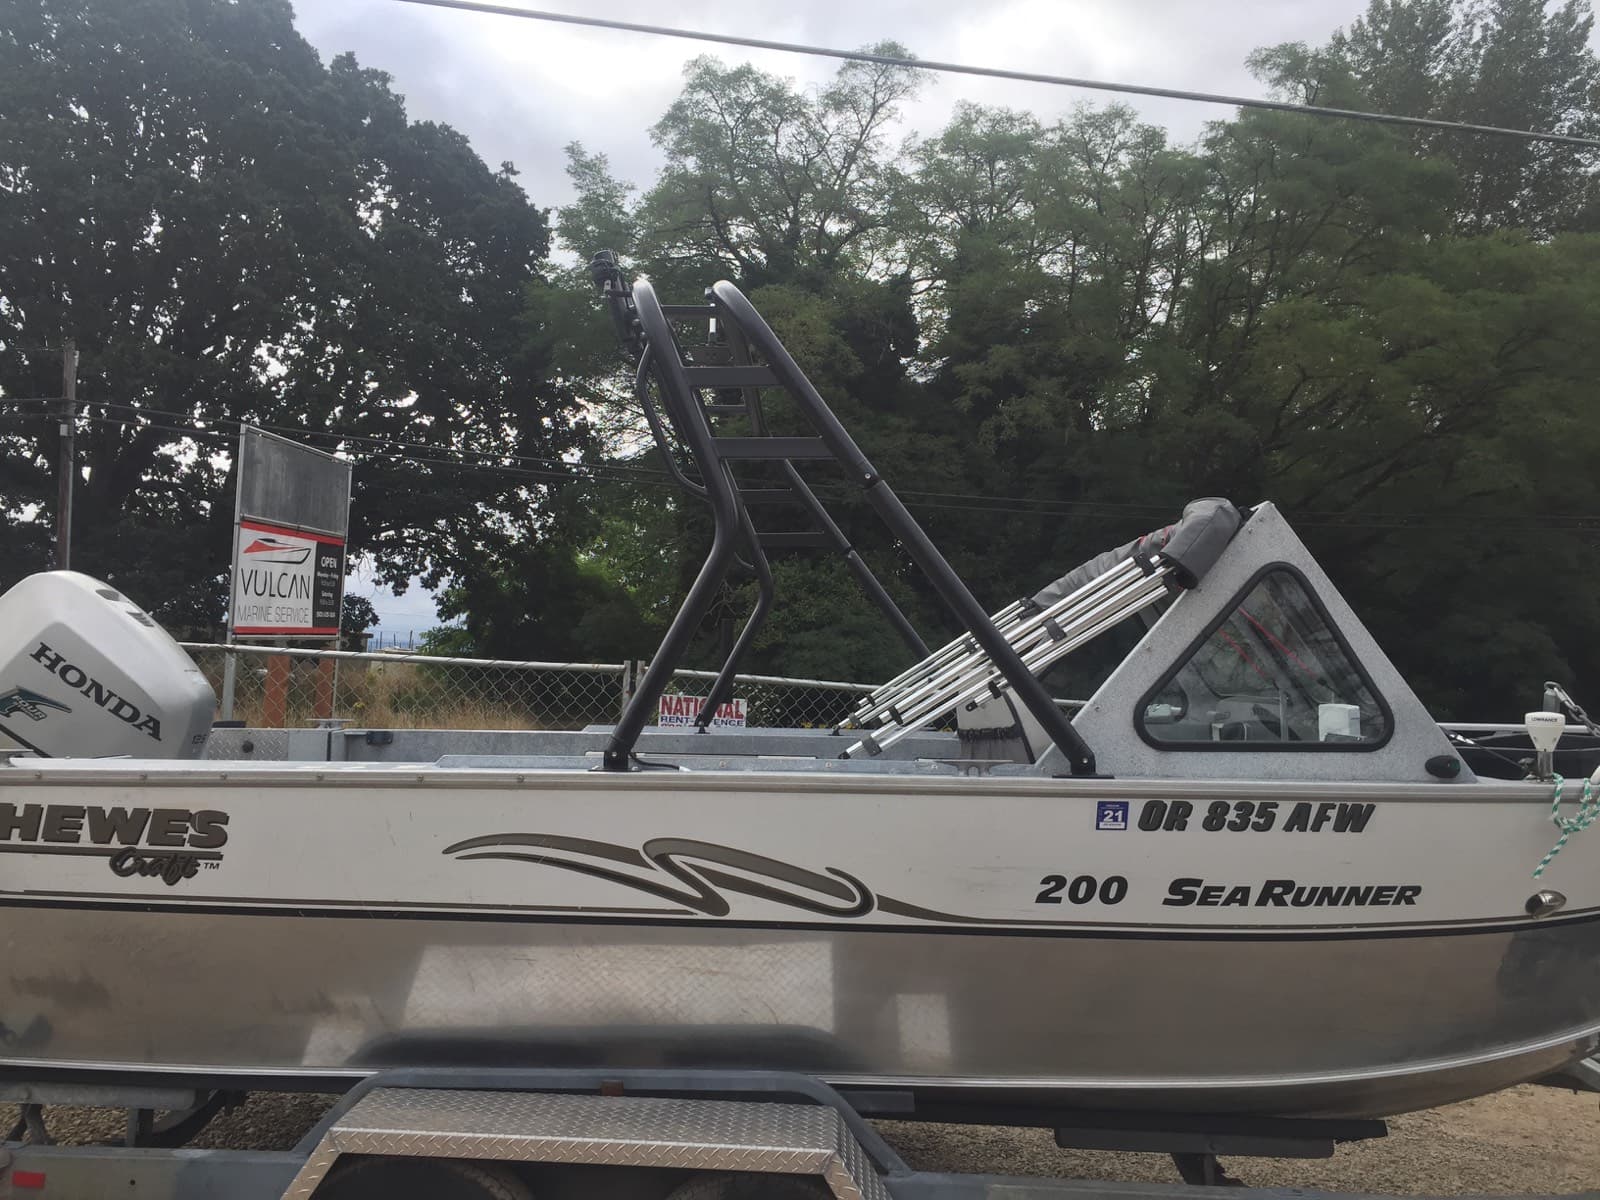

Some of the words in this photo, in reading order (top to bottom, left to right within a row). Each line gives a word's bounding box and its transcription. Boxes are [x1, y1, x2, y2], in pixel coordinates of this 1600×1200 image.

[320, 556, 337, 569] OPEN
[241, 568, 310, 599] VULCAN
[238, 605, 273, 622] MARINE
[275, 606, 309, 623] SERVICE
[30, 642, 162, 741] HONDA
[0, 803, 229, 848] HEWES
[1103, 810, 1123, 822] 21
[1137, 800, 1193, 831] OR
[1202, 801, 1279, 832] 835
[1282, 802, 1376, 832] AFW
[1036, 874, 1128, 905] 200
